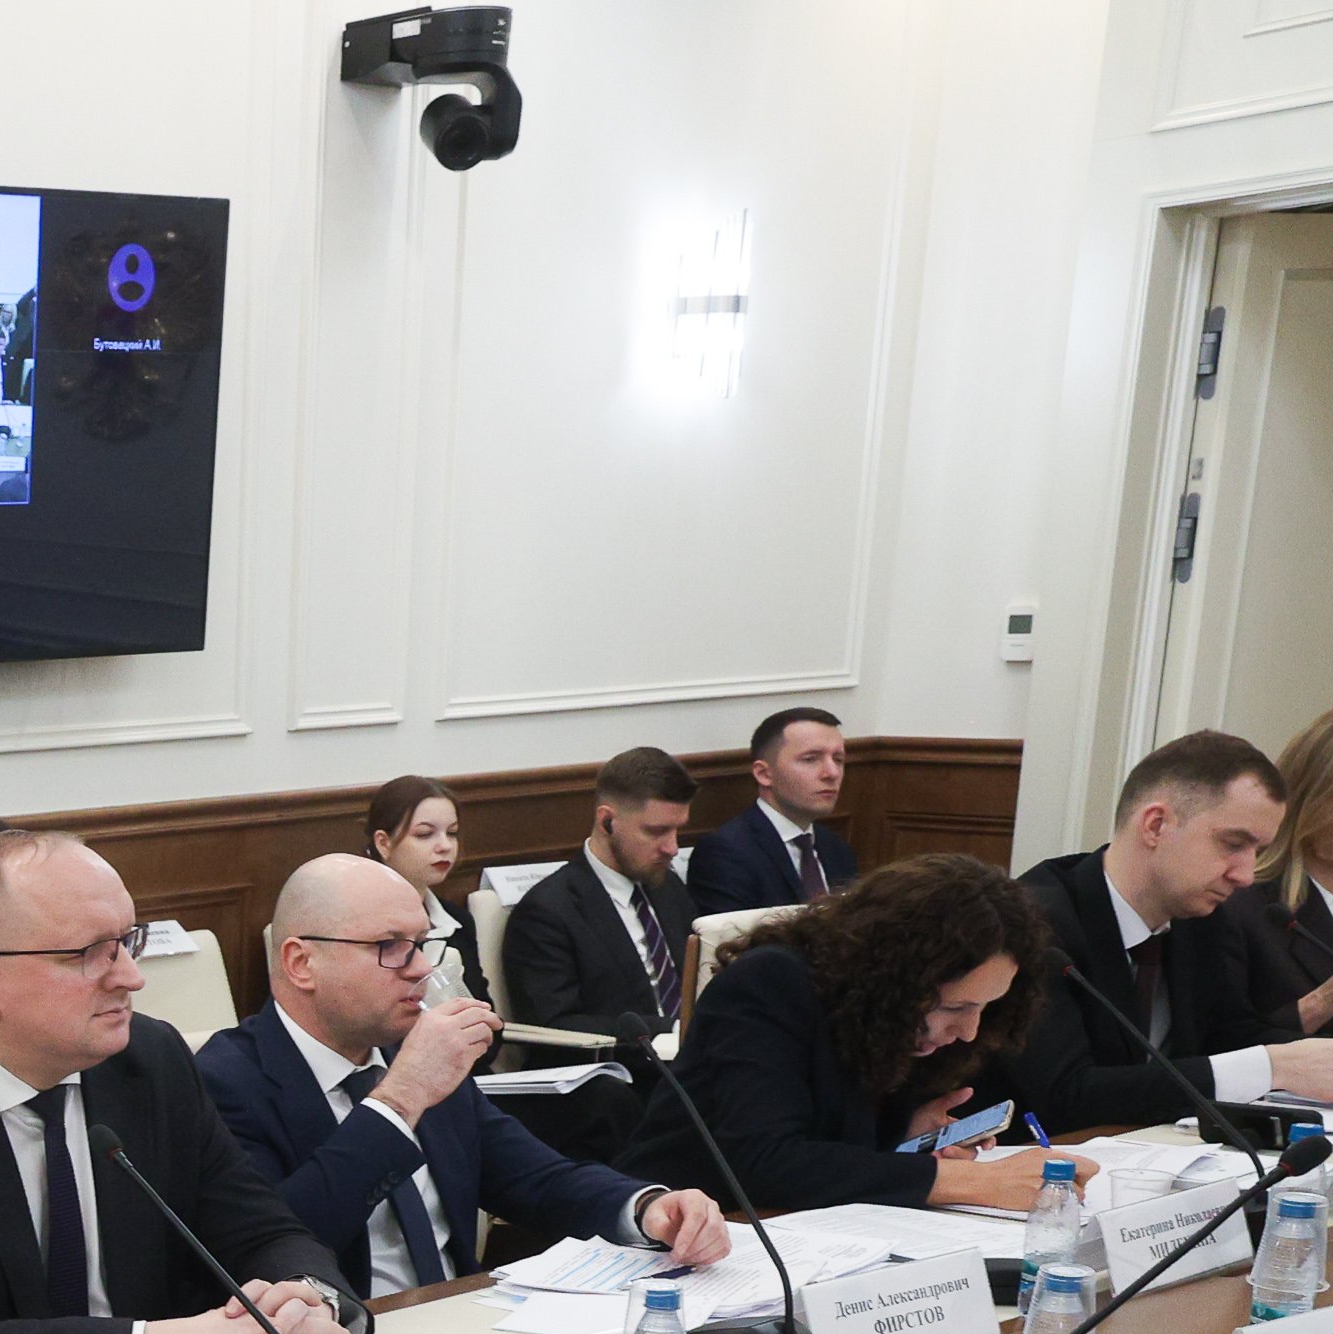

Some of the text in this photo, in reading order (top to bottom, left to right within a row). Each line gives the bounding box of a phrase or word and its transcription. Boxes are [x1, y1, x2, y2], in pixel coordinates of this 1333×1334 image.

[1120, 1219, 1174, 1243] Екатерина
[835, 1278, 970, 1320] Денис Александрович
[874, 1305, 945, 1334] ФИРСТОВ
